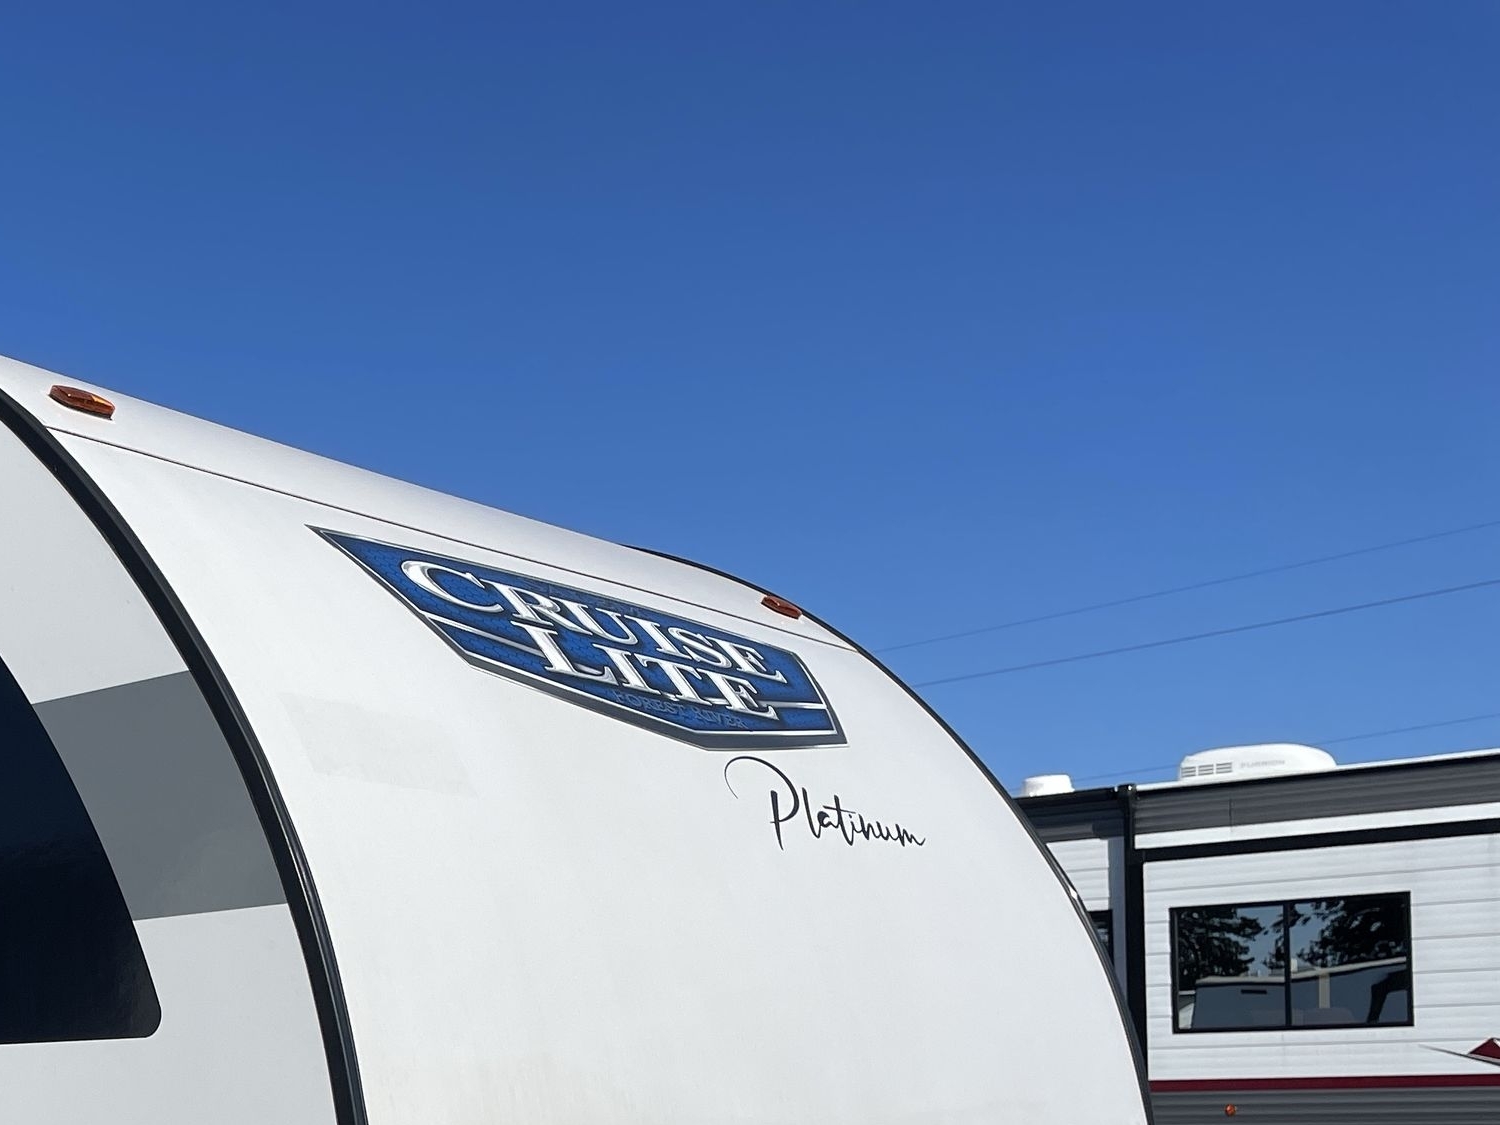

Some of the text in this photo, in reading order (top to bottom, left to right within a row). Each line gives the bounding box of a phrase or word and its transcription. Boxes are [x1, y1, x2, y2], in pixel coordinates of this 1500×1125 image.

[400, 560, 788, 684] CRUISE
[510, 620, 780, 721] LITE
[612, 690, 750, 730] FOREST RIVER
[724, 755, 926, 851] Platinum
